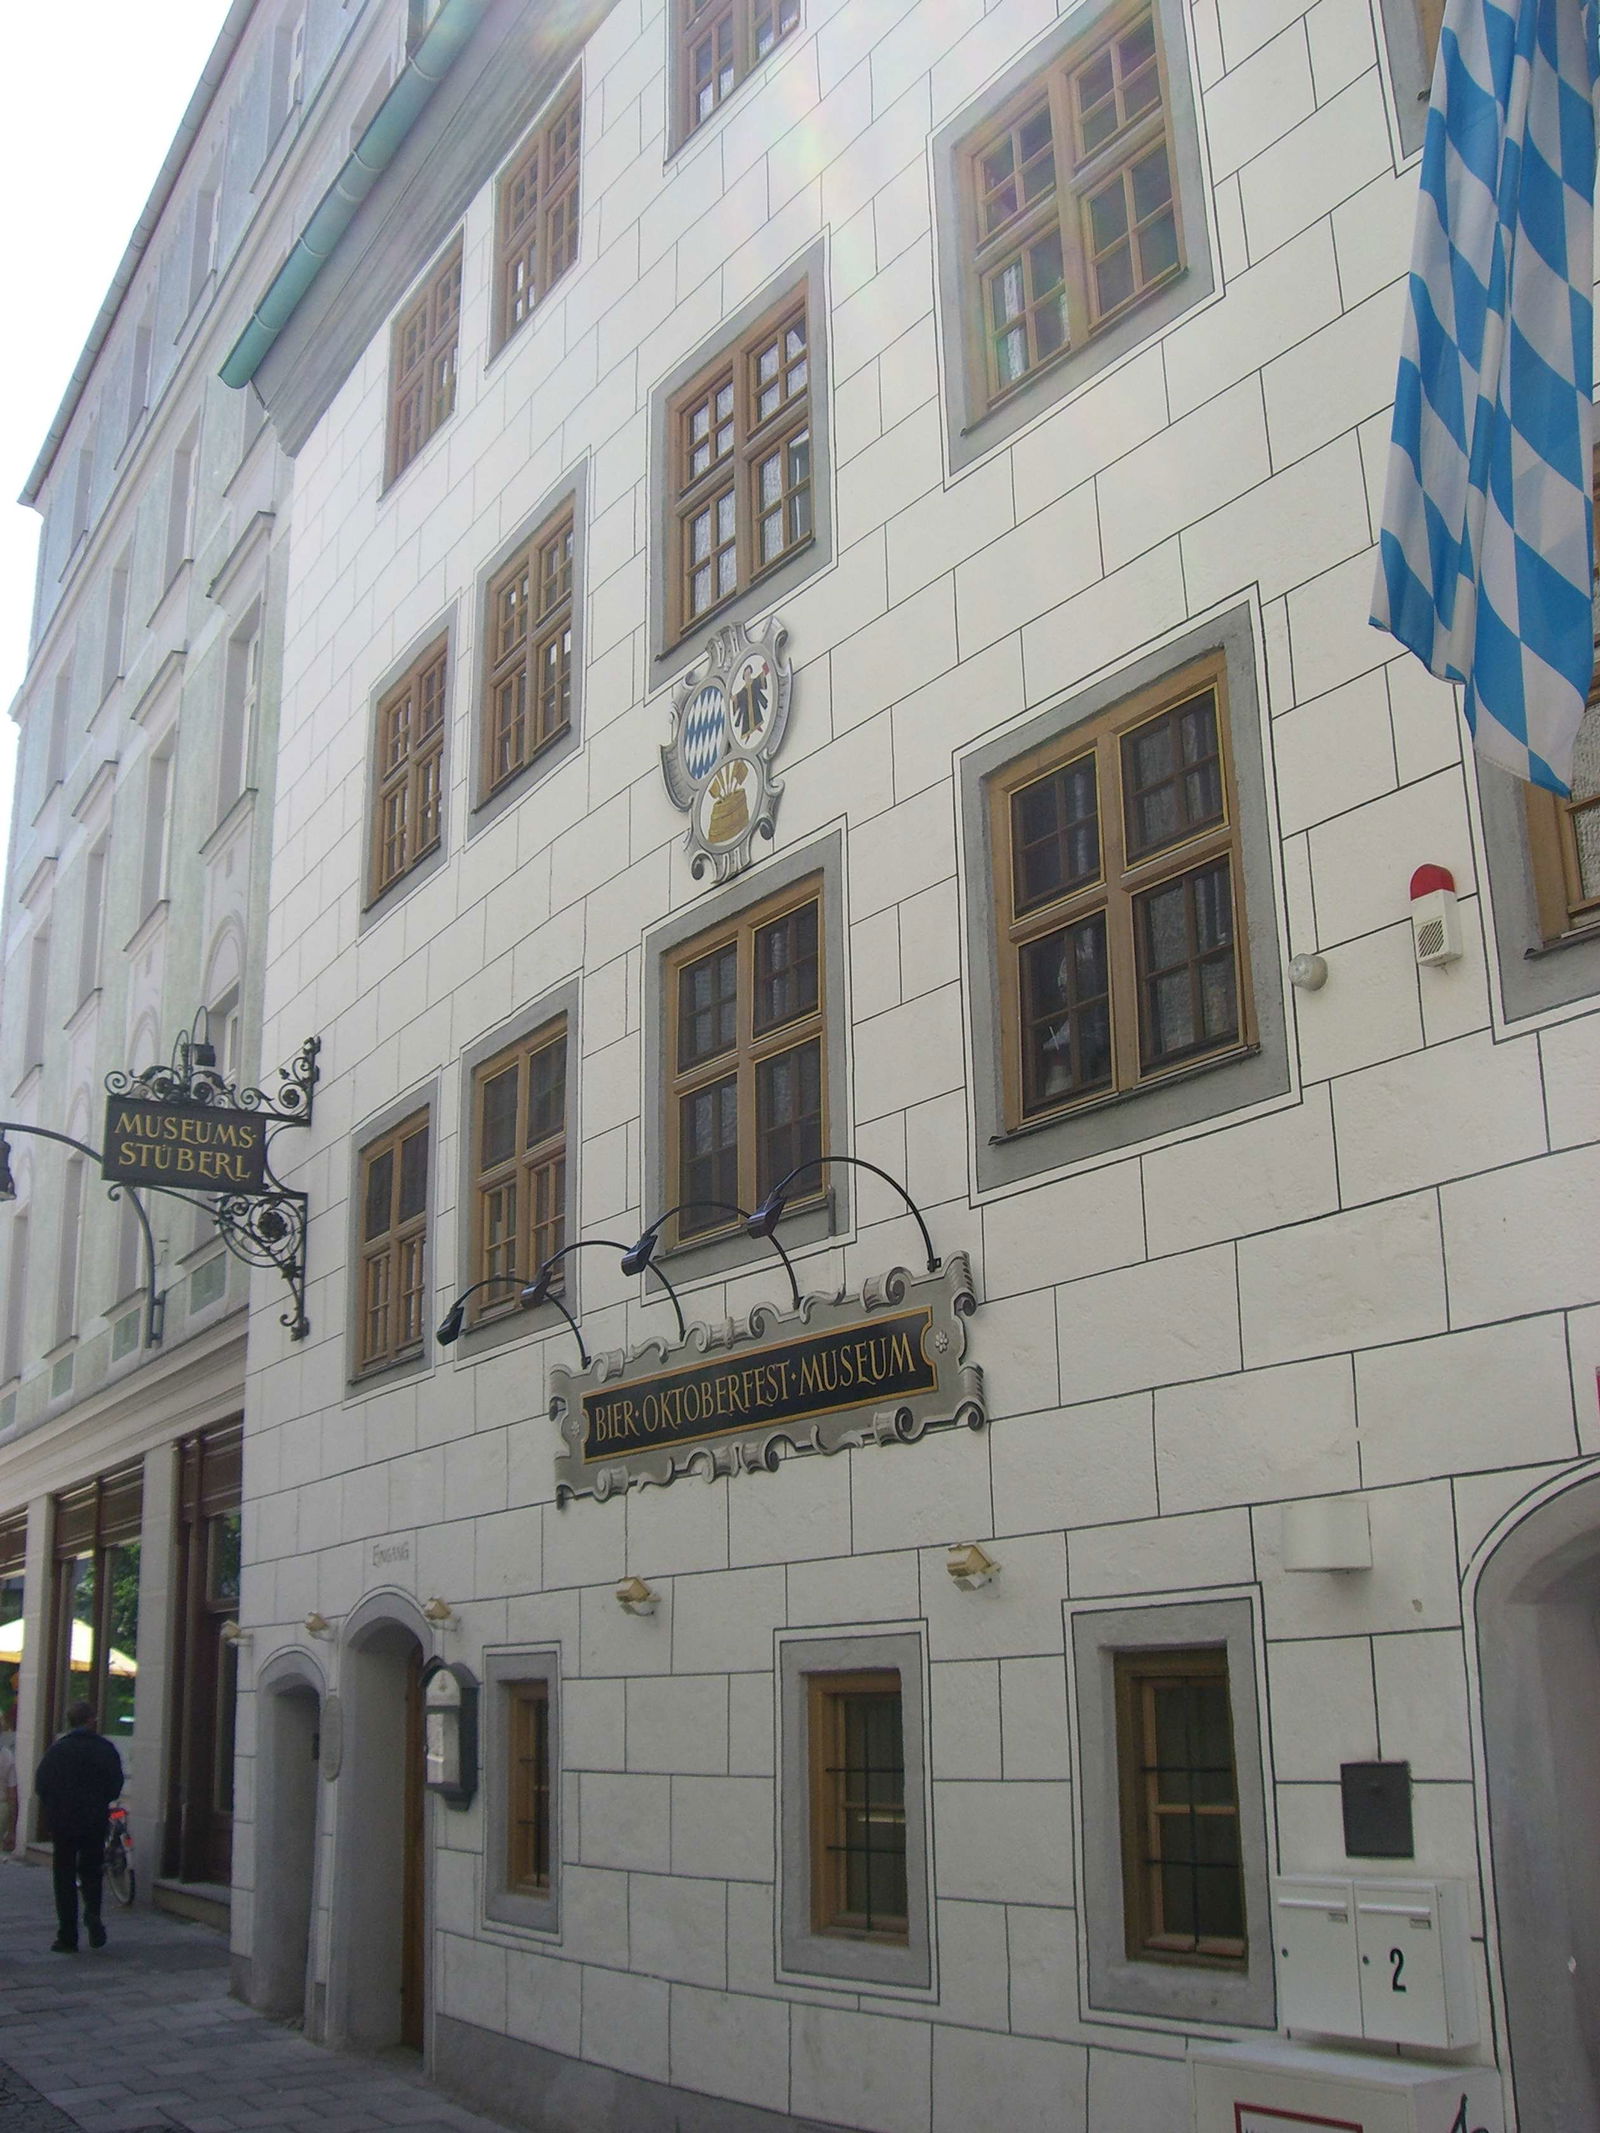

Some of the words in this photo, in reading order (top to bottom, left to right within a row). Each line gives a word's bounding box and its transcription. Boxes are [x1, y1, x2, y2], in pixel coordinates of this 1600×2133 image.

[118, 1141, 250, 1181] STÜBERL
[798, 1332, 917, 1396] MUSEUM
[1389, 1947, 1407, 1993] 2
